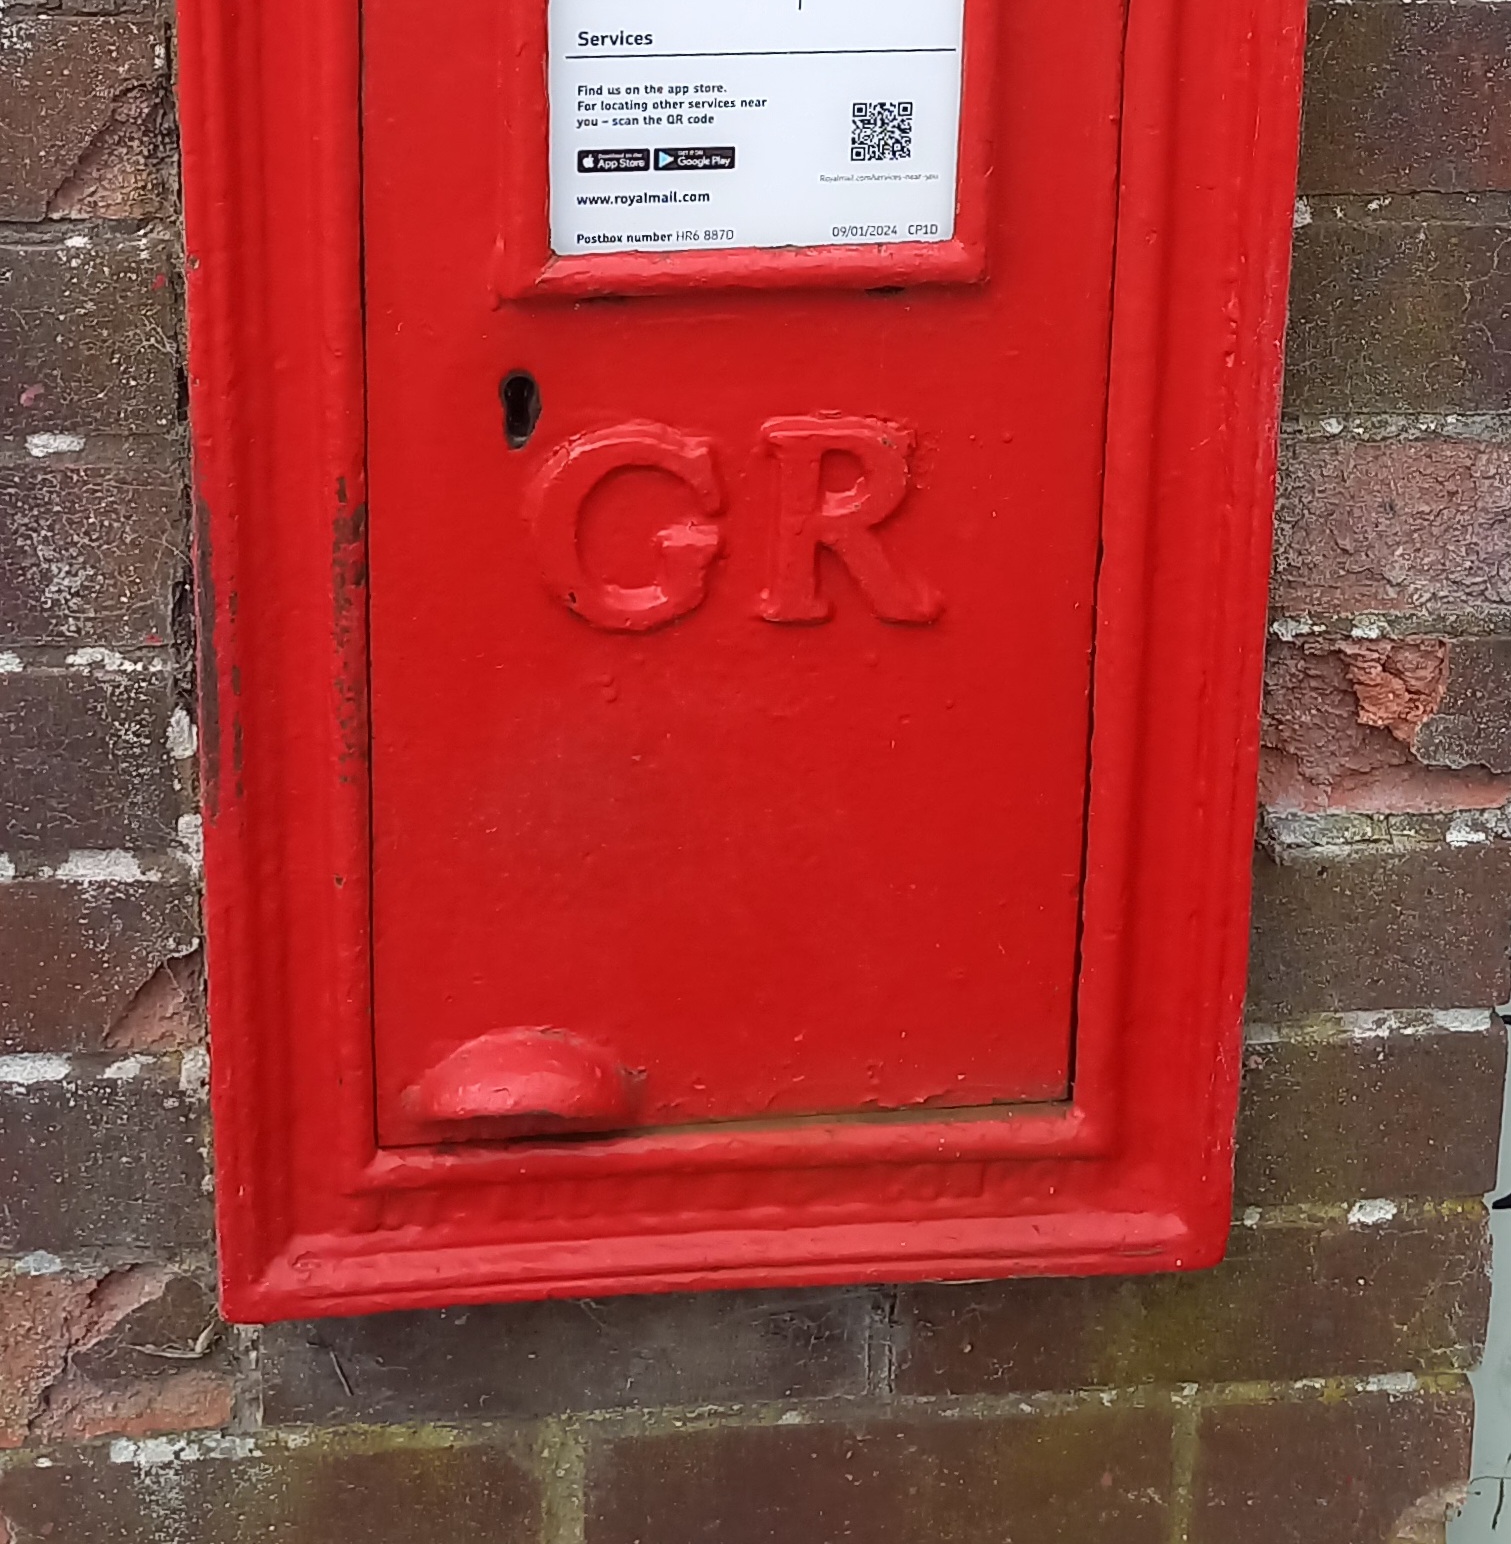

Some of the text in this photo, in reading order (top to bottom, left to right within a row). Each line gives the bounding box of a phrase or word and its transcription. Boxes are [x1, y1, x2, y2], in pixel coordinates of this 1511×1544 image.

[577, 29, 654, 47] Services
[577, 83, 728, 96] Find us on the app store.
[577, 97, 768, 113] For locating other services near
[575, 118, 598, 129] you
[612, 117, 639, 127] scan
[642, 114, 663, 126] the
[687, 113, 715, 125] code
[598, 159, 645, 169] App Store
[678, 156, 731, 167] Google Play
[576, 190, 711, 207] www.royalmail.com
[576, 229, 735, 245] Postbox number HR6 8870
[831, 223, 939, 239] 09/01/2024 CP1D
